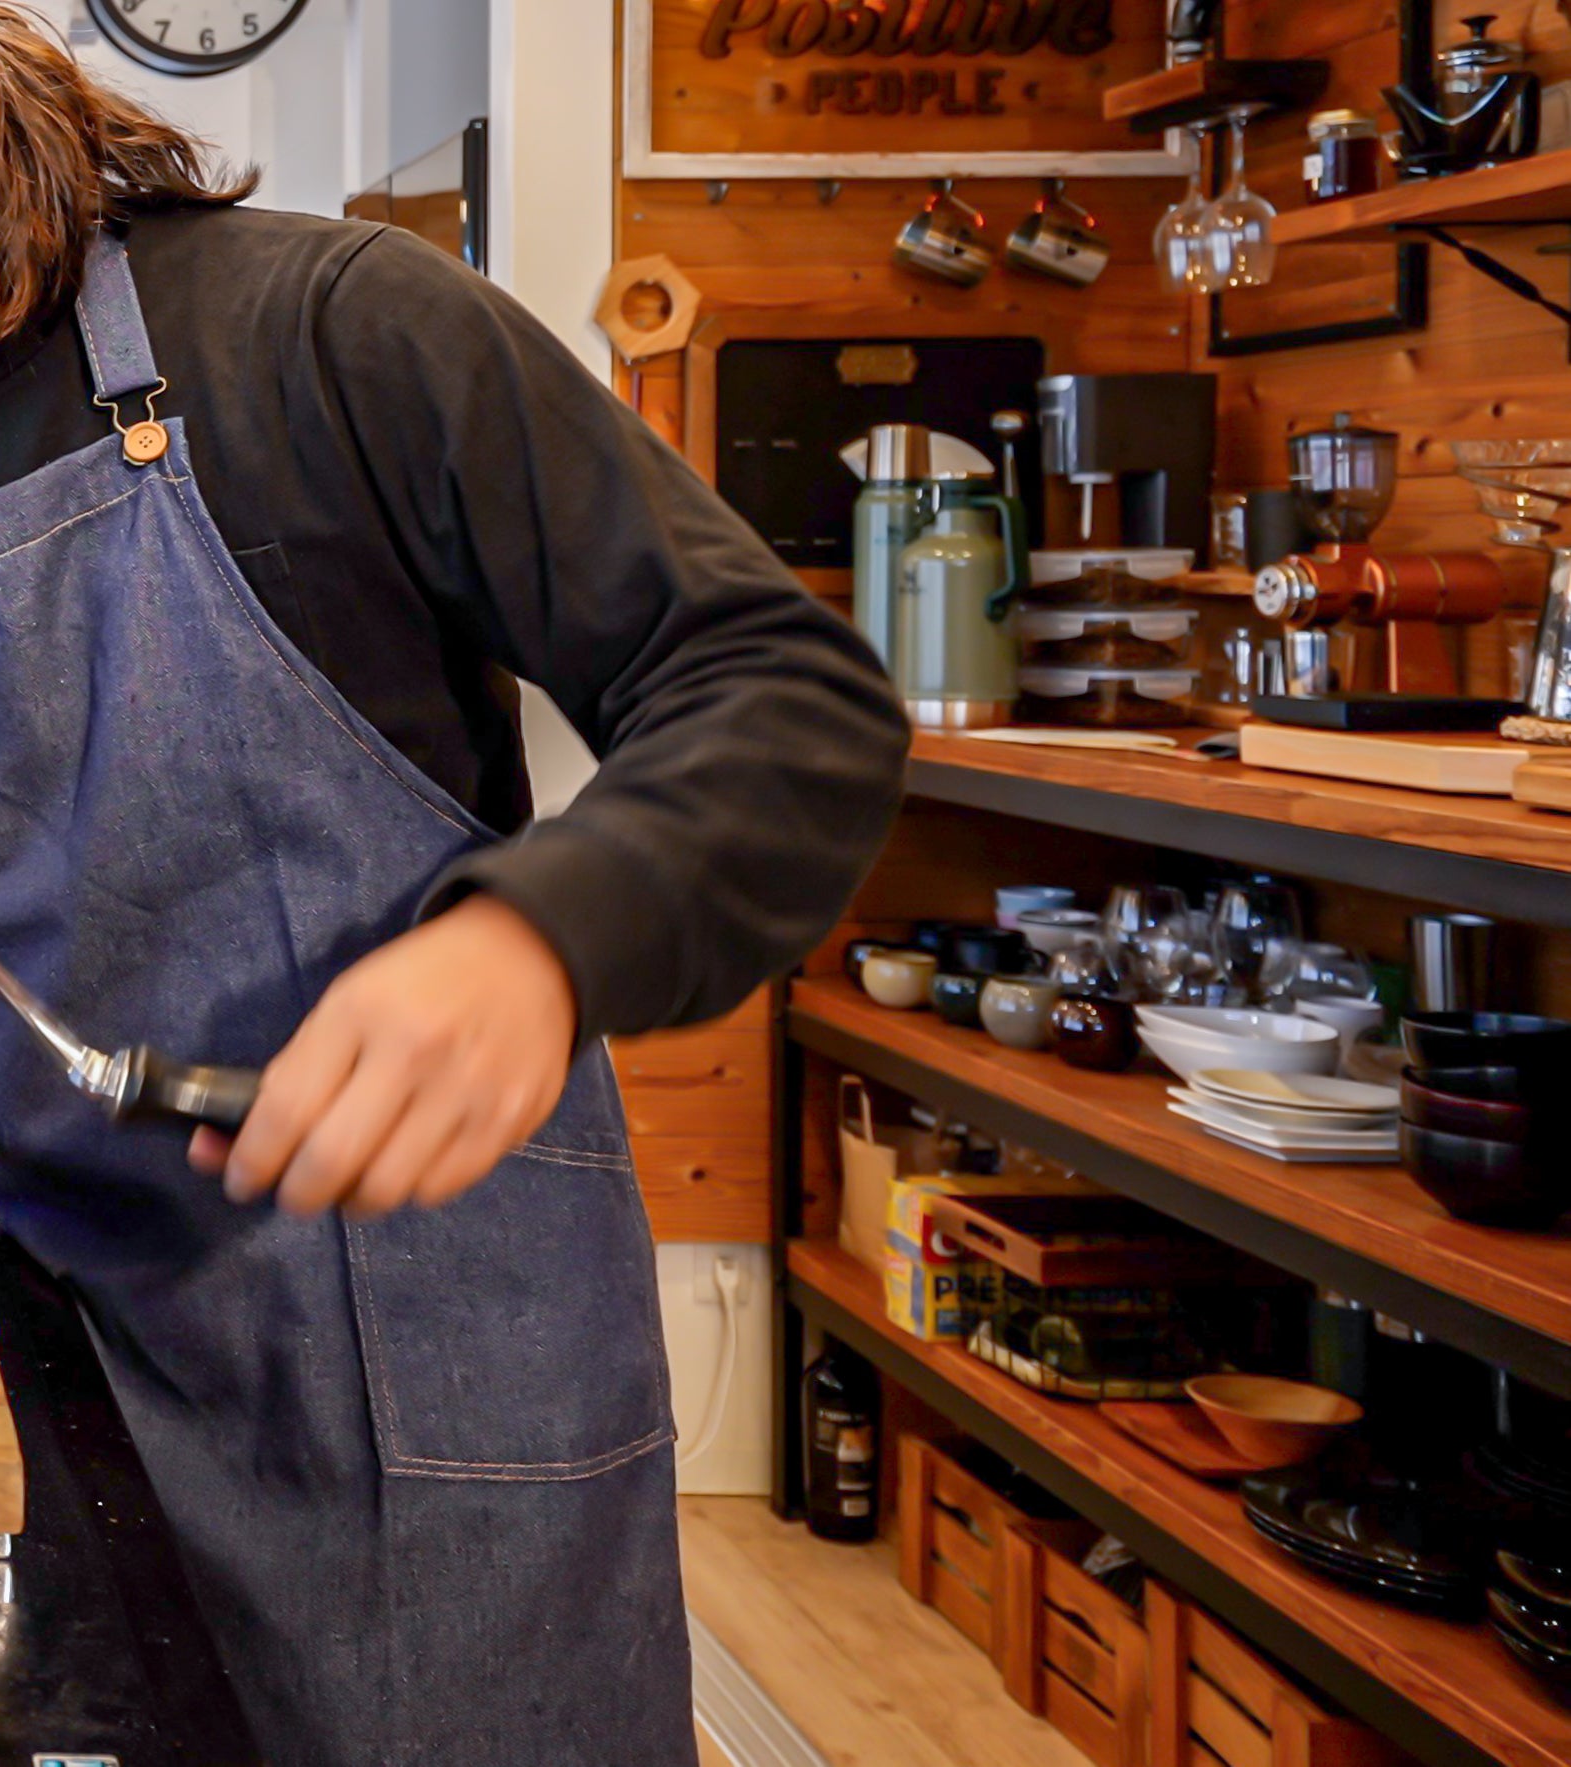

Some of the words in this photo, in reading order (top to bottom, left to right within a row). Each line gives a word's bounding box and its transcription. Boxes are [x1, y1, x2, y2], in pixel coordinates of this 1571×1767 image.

[153, 20, 171, 44] 7
[242, 13, 259, 36] 5
[199, 28, 216, 52] 6
[806, 67, 1007, 117] PEOPLE
